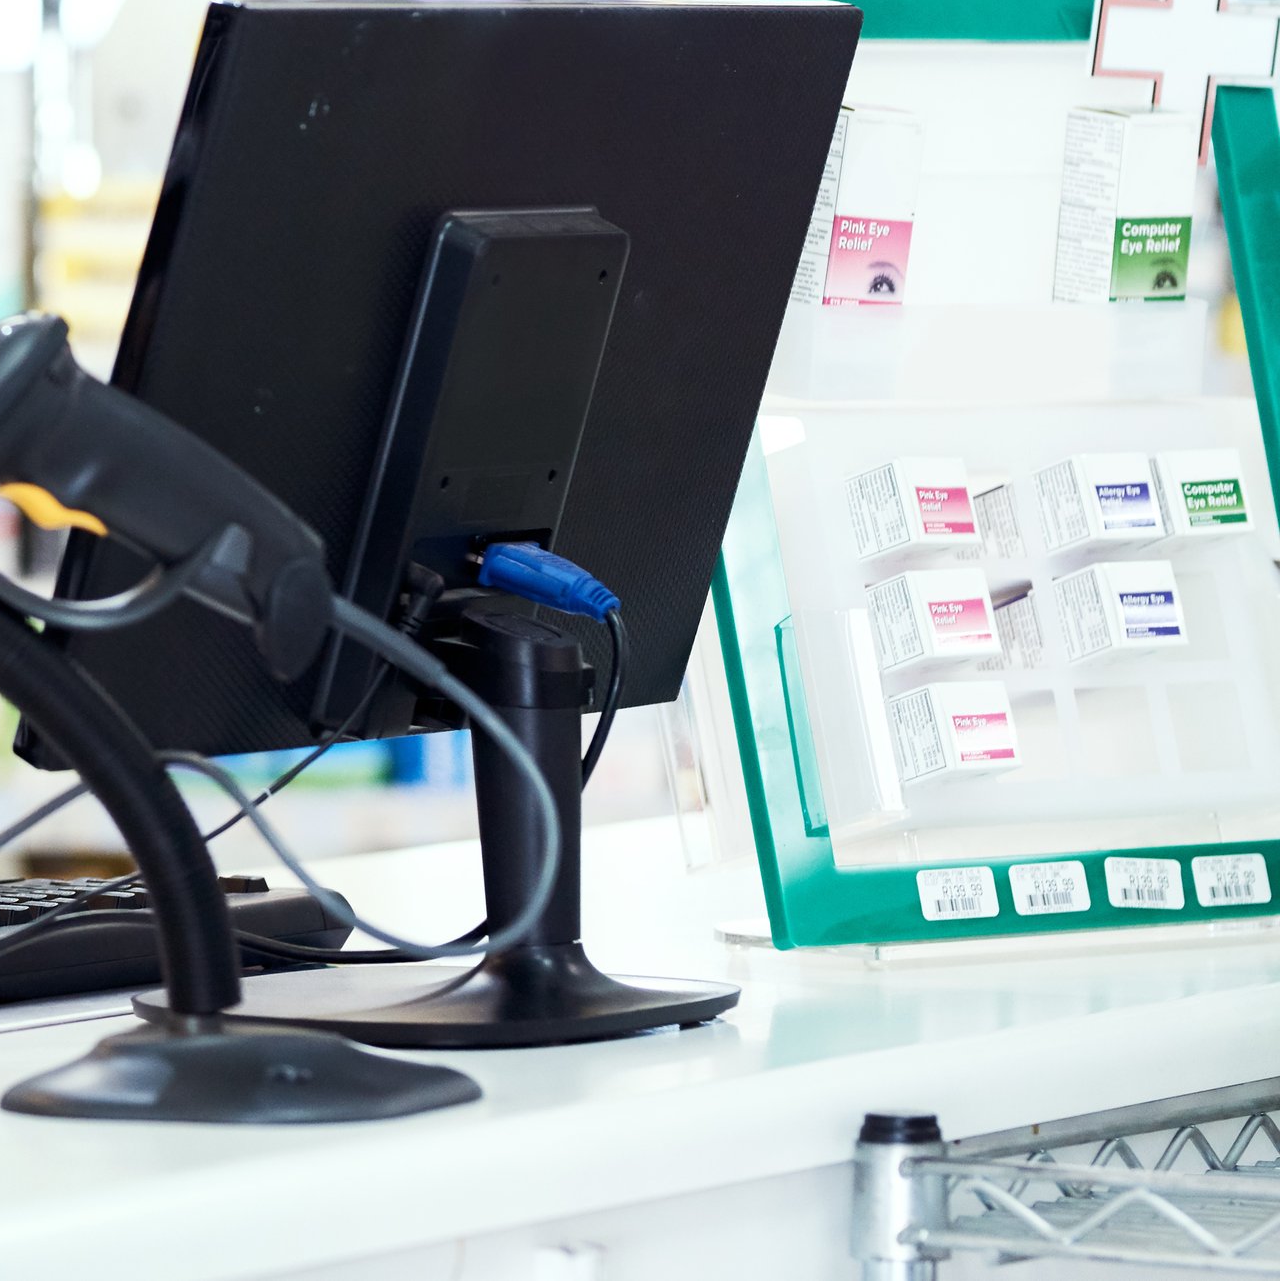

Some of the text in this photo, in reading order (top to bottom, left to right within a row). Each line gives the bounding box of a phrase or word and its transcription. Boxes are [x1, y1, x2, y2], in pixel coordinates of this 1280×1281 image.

[840, 220, 890, 237] Pink Eye
[1122, 222, 1182, 240] Computer
[839, 236, 872, 251] Relief
[1121, 237, 1181, 256] Eye Relief
[919, 490, 949, 502] Pink Eye
[1099, 485, 1141, 498] Allergy Eye
[1184, 482, 1235, 496] Computer
[1187, 493, 1238, 510] Eye Relief
[1122, 593, 1165, 606] Allergy Eye
[931, 603, 963, 615] Pink Eye
[955, 716, 973, 727] Pink
